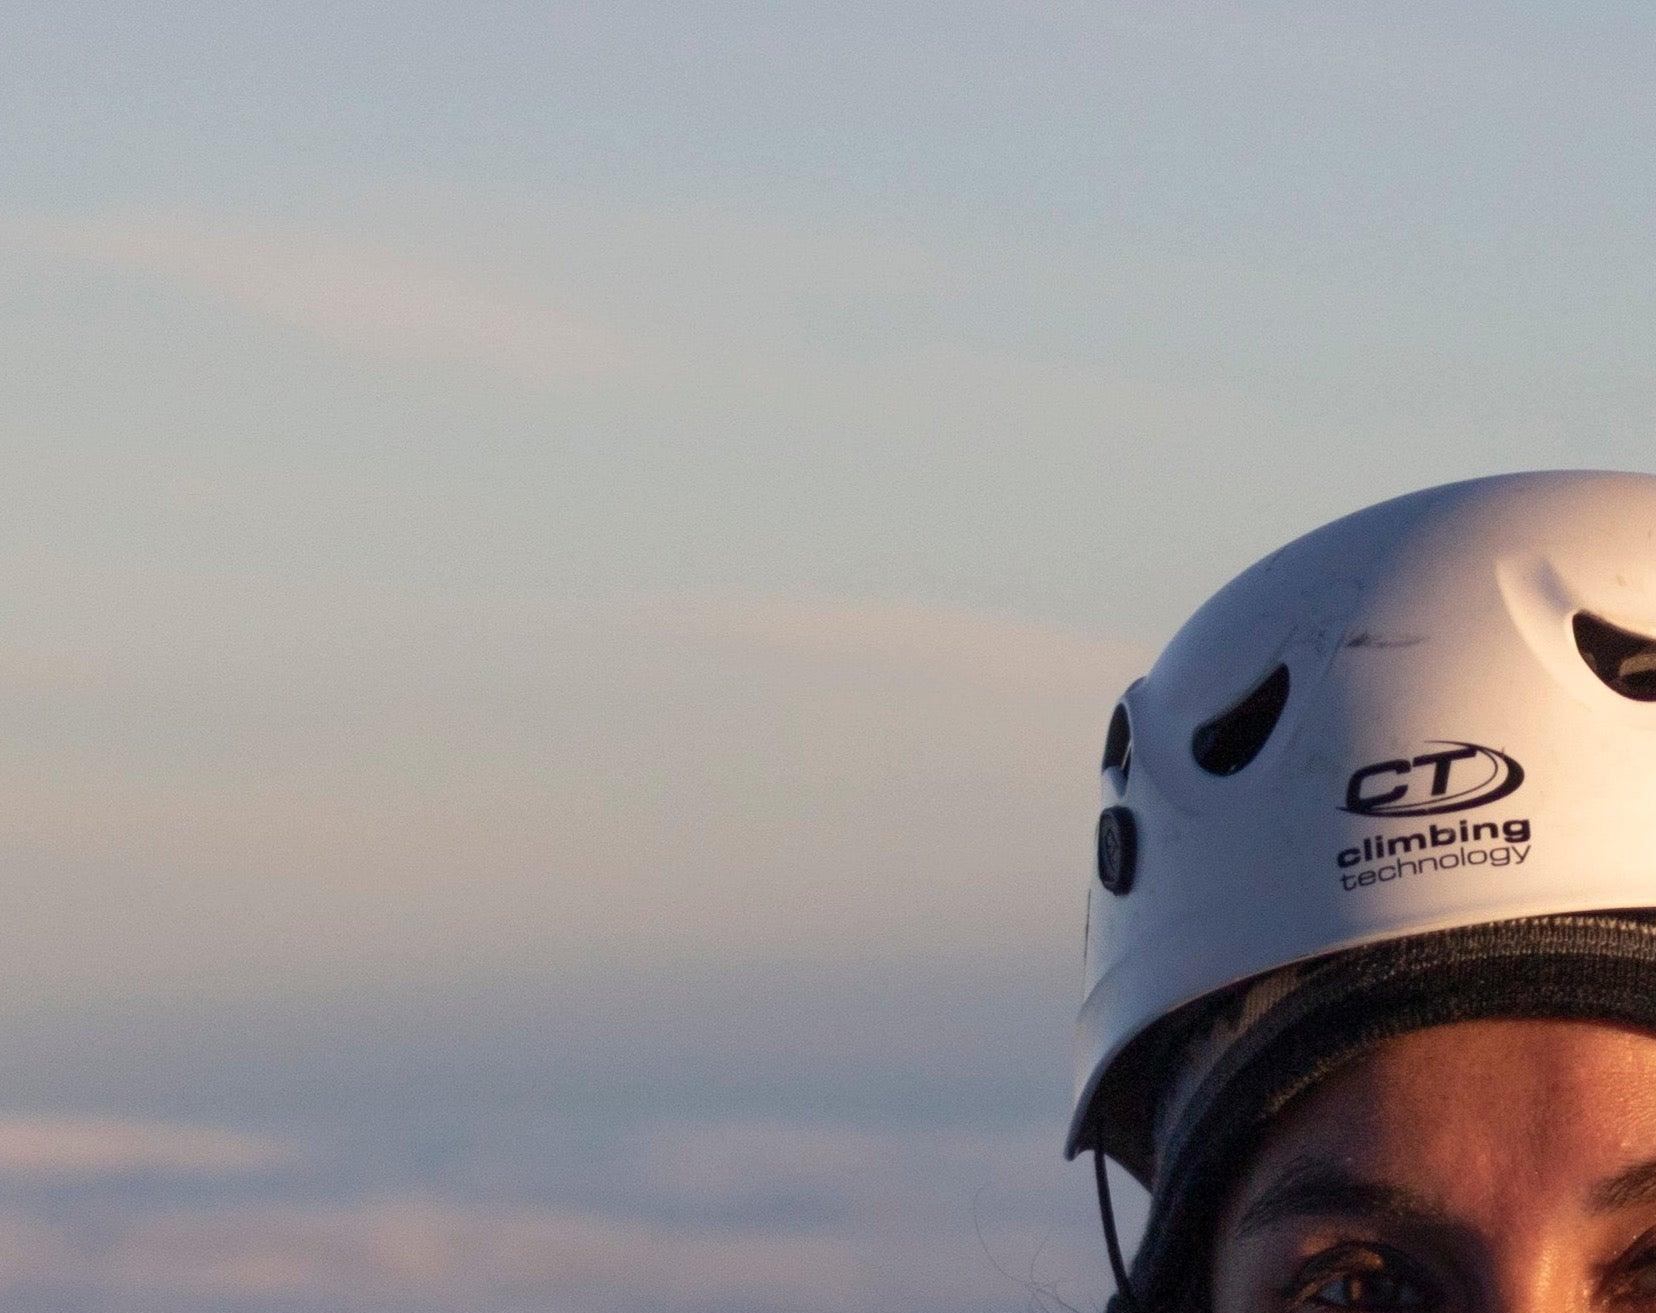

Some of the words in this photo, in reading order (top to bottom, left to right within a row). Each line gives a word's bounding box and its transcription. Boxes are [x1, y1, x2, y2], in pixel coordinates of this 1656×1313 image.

[1345, 747, 1478, 811] CT
[1337, 819, 1531, 868] climbing
[1340, 845, 1531, 892] technology
